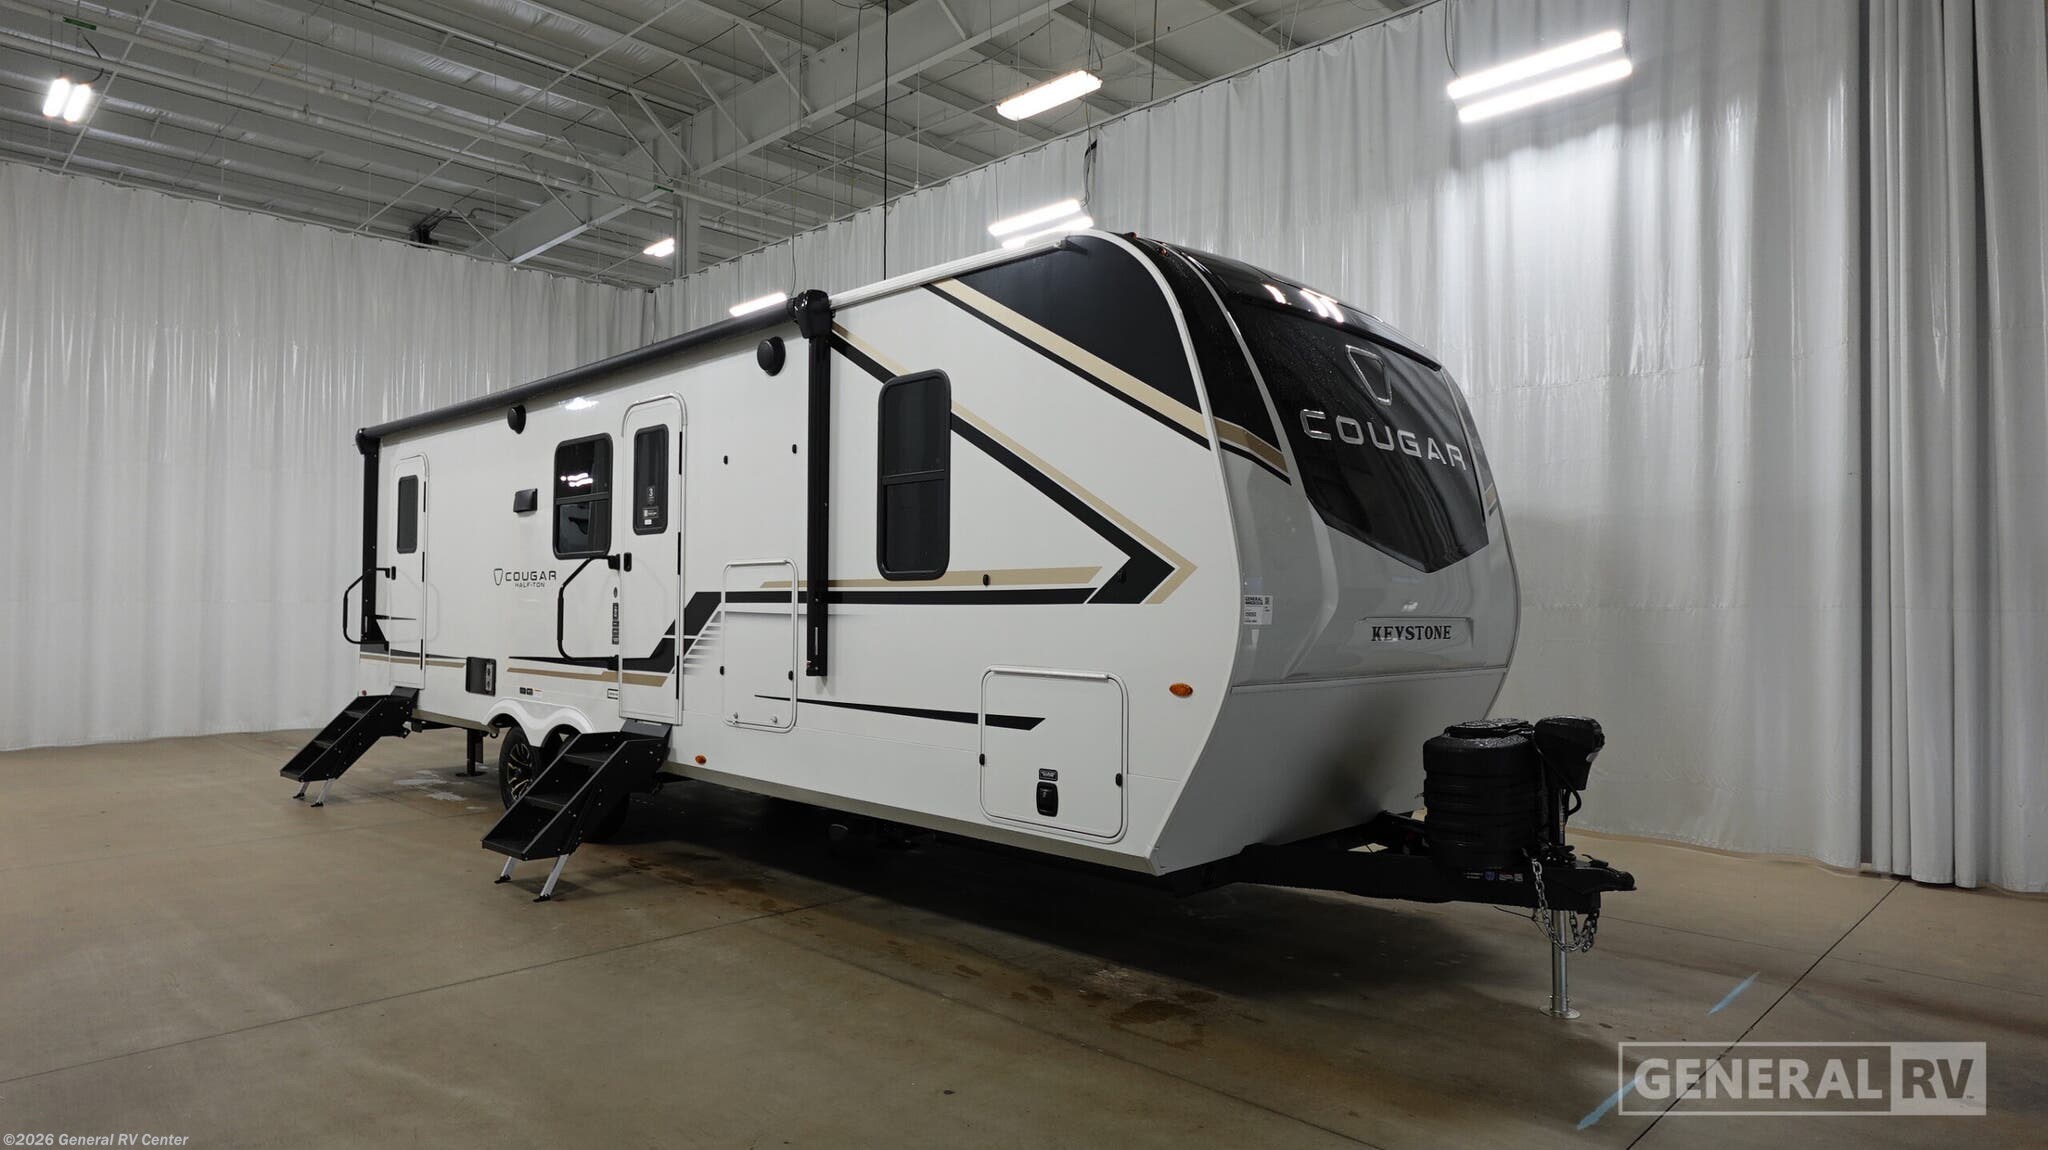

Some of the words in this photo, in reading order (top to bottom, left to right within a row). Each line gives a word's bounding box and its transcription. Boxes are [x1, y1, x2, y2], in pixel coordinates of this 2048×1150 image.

[1300, 409, 1467, 471] COUGAR
[505, 570, 557, 582] COUGAR
[1371, 625, 1452, 642] KEYSTONE
